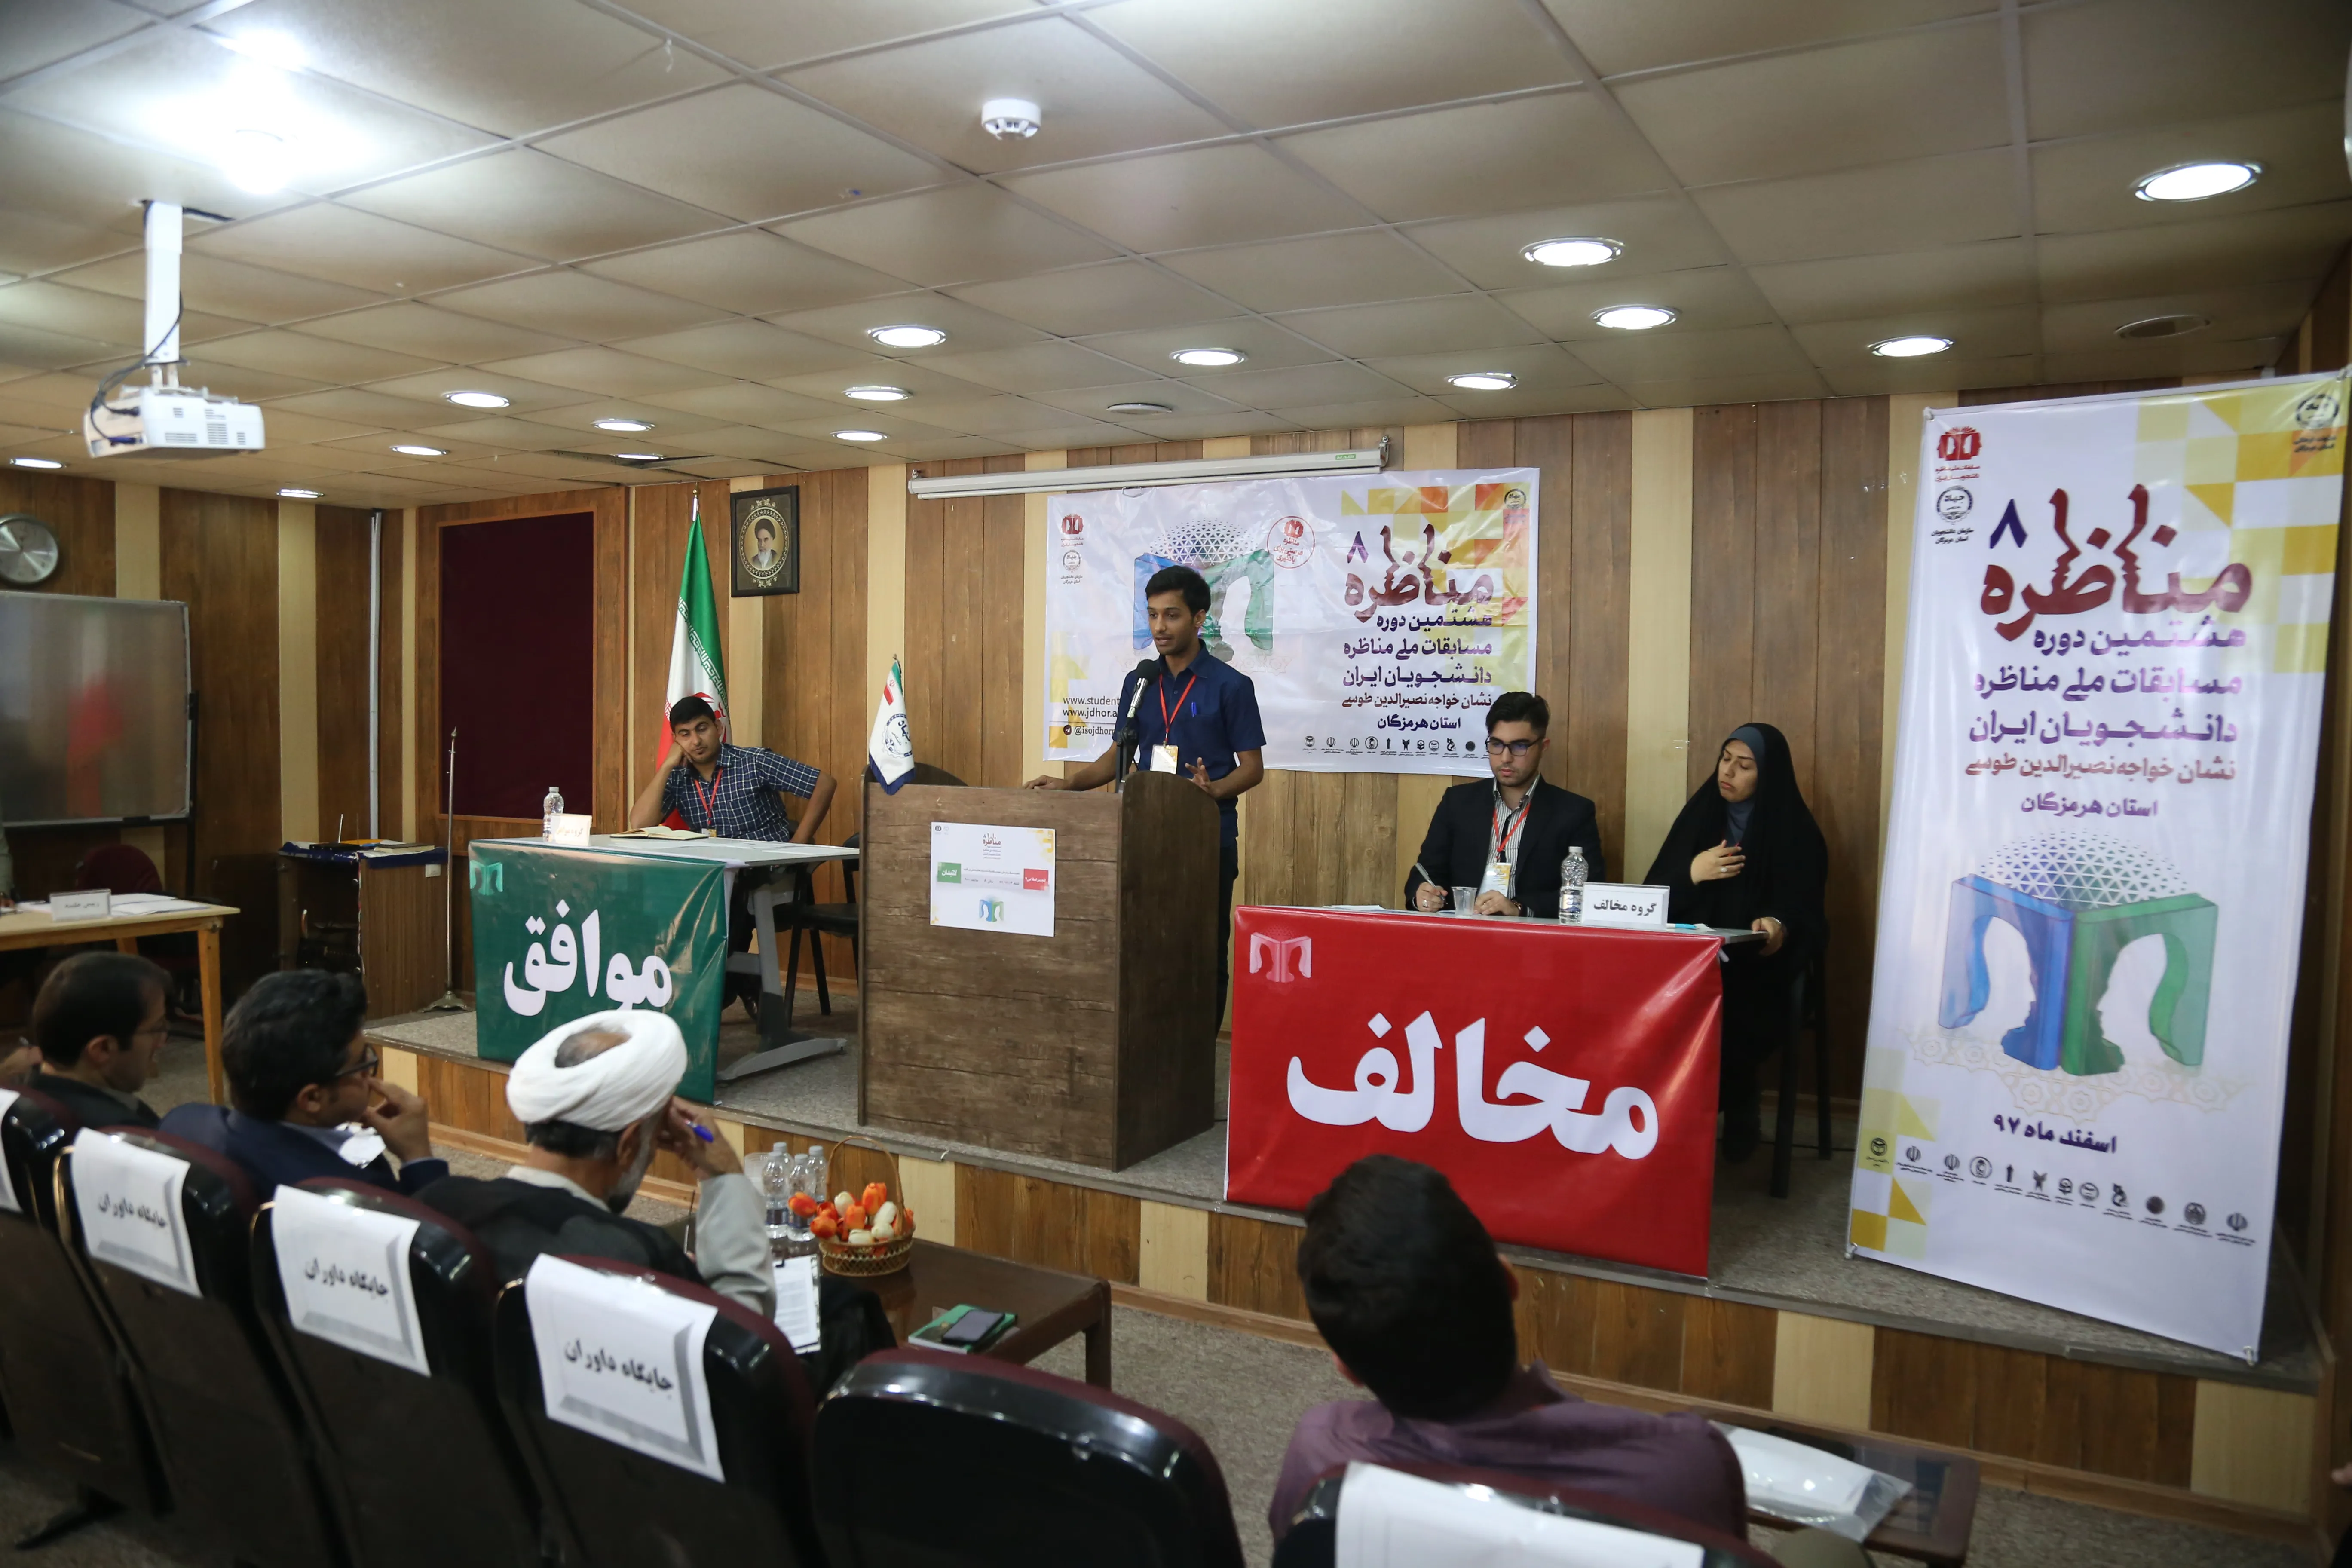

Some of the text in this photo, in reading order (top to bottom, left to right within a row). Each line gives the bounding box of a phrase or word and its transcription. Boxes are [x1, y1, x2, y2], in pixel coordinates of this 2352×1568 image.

[1376, 606, 1492, 632] هشتمین دوره
[1344, 637, 1393, 659] مناظره
[1421, 637, 1492, 660] مسابقات
[2034, 615, 2247, 656] هشتمین دوره
[1343, 662, 1492, 688] دانشجویان ایران
[1974, 665, 2060, 700] مناظره
[2110, 666, 2242, 702] مسابقات
[1063, 696, 1121, 705] www.student
[1063, 707, 1118, 719] www.jdhor.a
[1461, 692, 1492, 709] نشان
[1377, 714, 1461, 731] استان هرمزگان
[1969, 707, 2238, 747] دانشجویان ایران
[2177, 756, 2236, 784] نشان
[2021, 791, 2158, 818] استان هرمزگان
[1594, 899, 1657, 916] گروه مخالف
[504, 899, 672, 1017] موافق
[1286, 1010, 1660, 1161] مخالف
[1993, 1114, 2117, 1154] اسفند ماه ۹۷
[98, 1192, 134, 1219] داوران
[304, 1256, 346, 1287] داوران
[564, 1338, 674, 1400] جایگاه داوران
